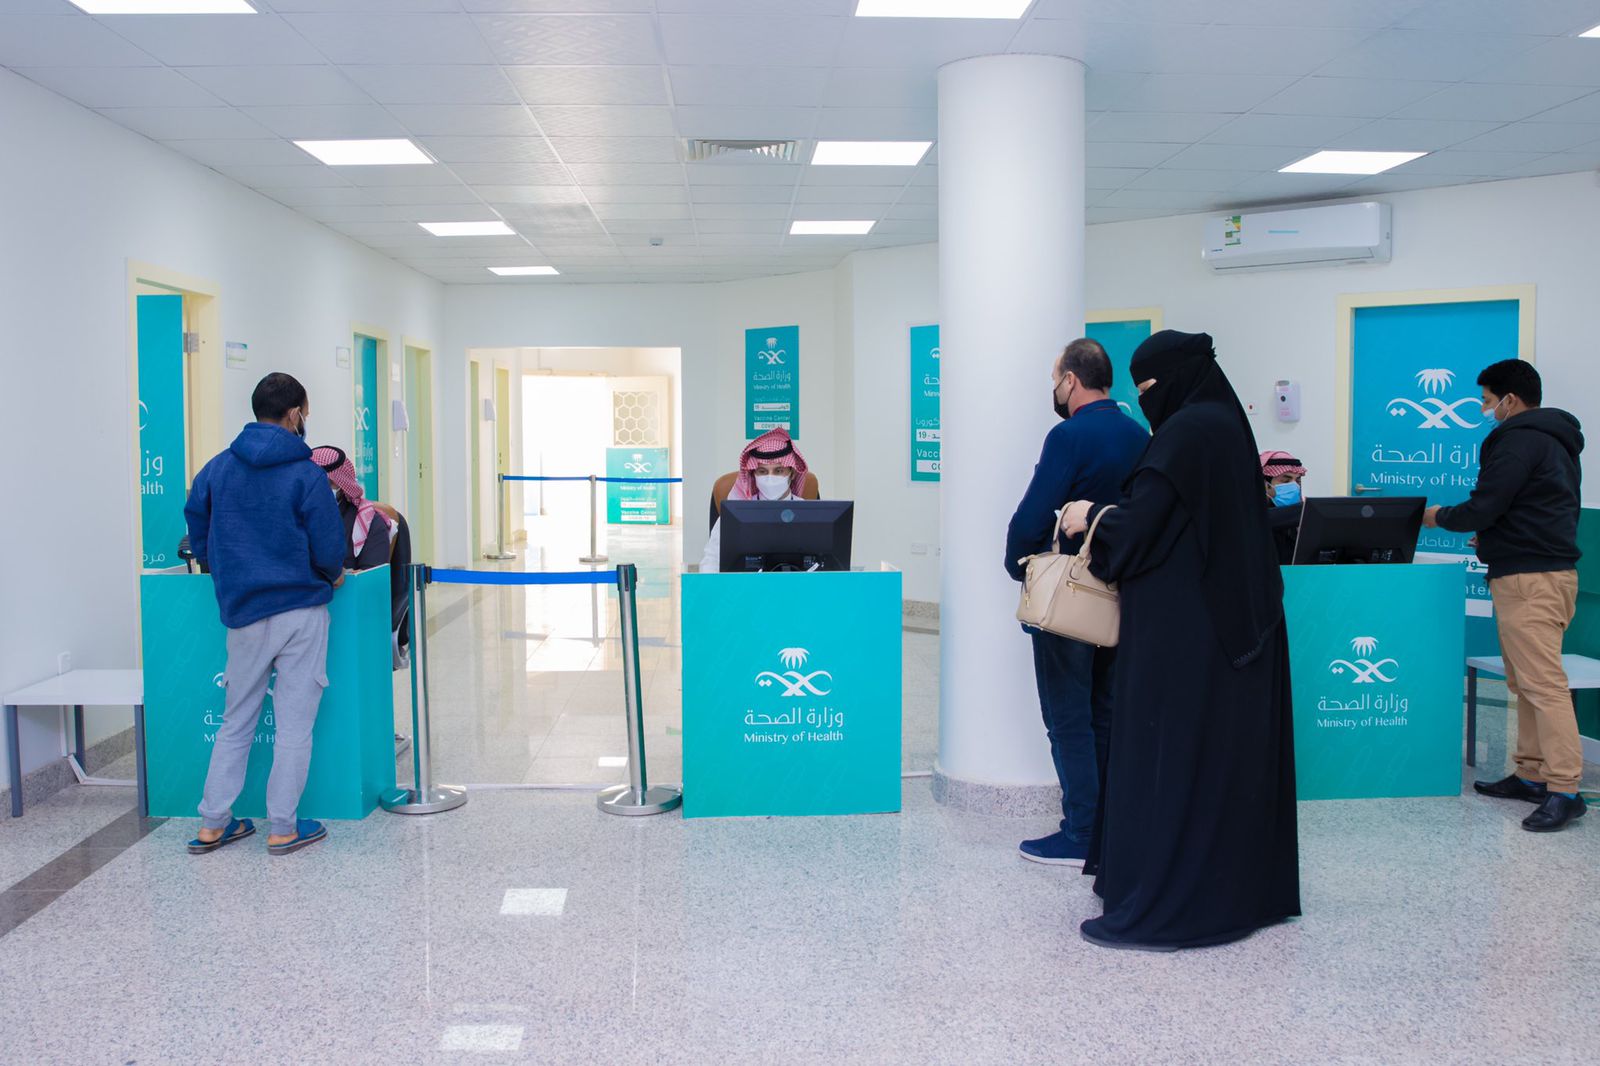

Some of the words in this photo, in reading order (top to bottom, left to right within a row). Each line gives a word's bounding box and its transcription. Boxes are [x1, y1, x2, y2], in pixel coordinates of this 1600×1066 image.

[918, 431, 927, 439] 19
[1371, 443, 1443, 464] الصحة
[1450, 443, 1480, 470] ارة
[140, 481, 164, 495] alth
[1370, 471, 1426, 488] Ministry
[1430, 472, 1448, 486] of
[1451, 473, 1479, 487] Hea
[1317, 693, 1370, 711] الصحة
[1374, 693, 1408, 713] وزارة
[744, 706, 801, 725] الصحة
[806, 706, 844, 728] وزارة
[1317, 717, 1357, 730] Ministry
[1360, 716, 1373, 727] of
[1375, 716, 1408, 727] Health
[744, 731, 789, 745] Ministry
[792, 730, 806, 742] of
[807, 730, 844, 742] Health
